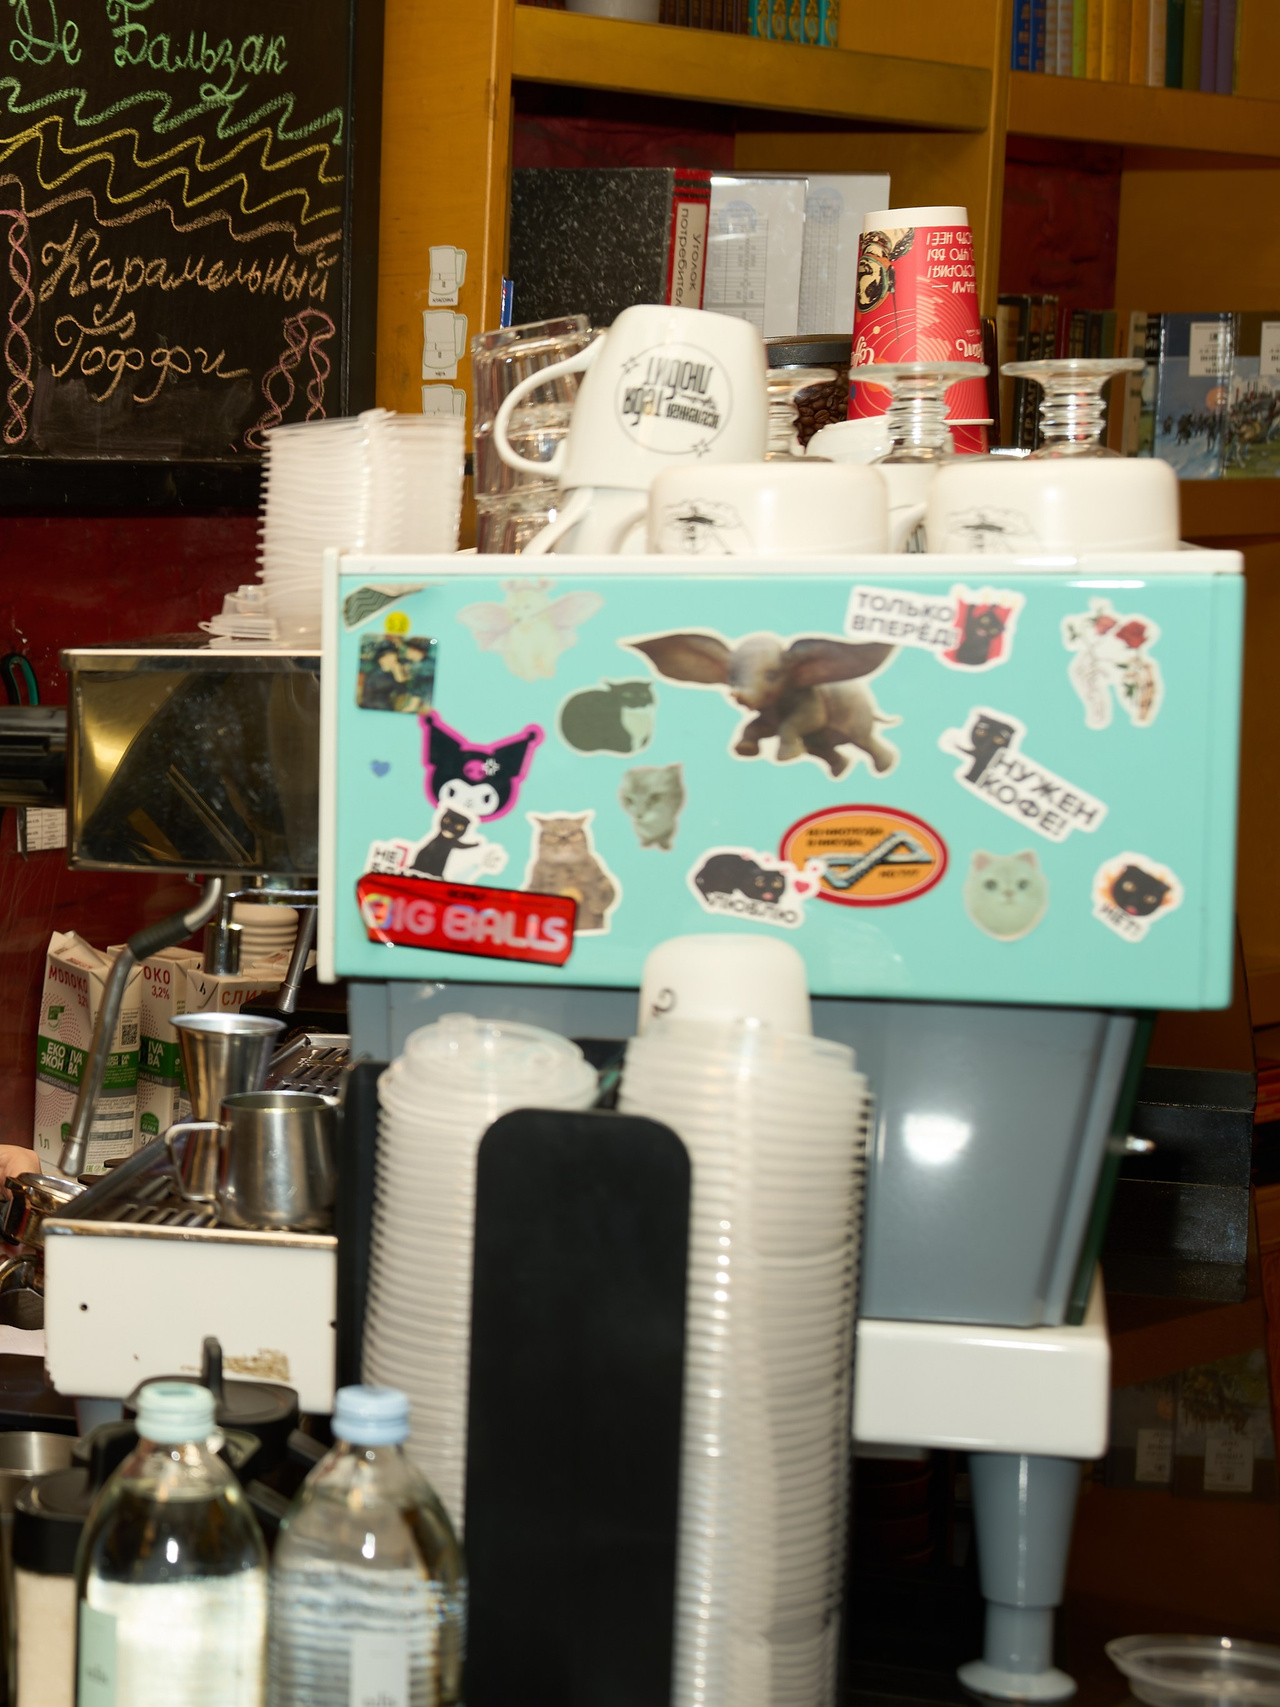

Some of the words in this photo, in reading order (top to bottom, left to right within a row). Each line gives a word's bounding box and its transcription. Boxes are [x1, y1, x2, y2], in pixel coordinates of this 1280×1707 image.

[107, 0, 290, 101] Бальзак
[38, 222, 342, 328] Карамельный
[675, 207, 689, 307] потребител
[689, 233, 702, 293] Уголок
[856, 591, 955, 624] ТОЛЬКО
[980, 772, 1069, 838] КОФЕ!
[992, 751, 1099, 828] НУЖЕН
[363, 892, 436, 936] BIG
[442, 903, 569, 954] BALLS
[48, 964, 89, 995] МОЛОКО
[143, 964, 171, 986] ОКО
[221, 989, 267, 1006] СЛИ
